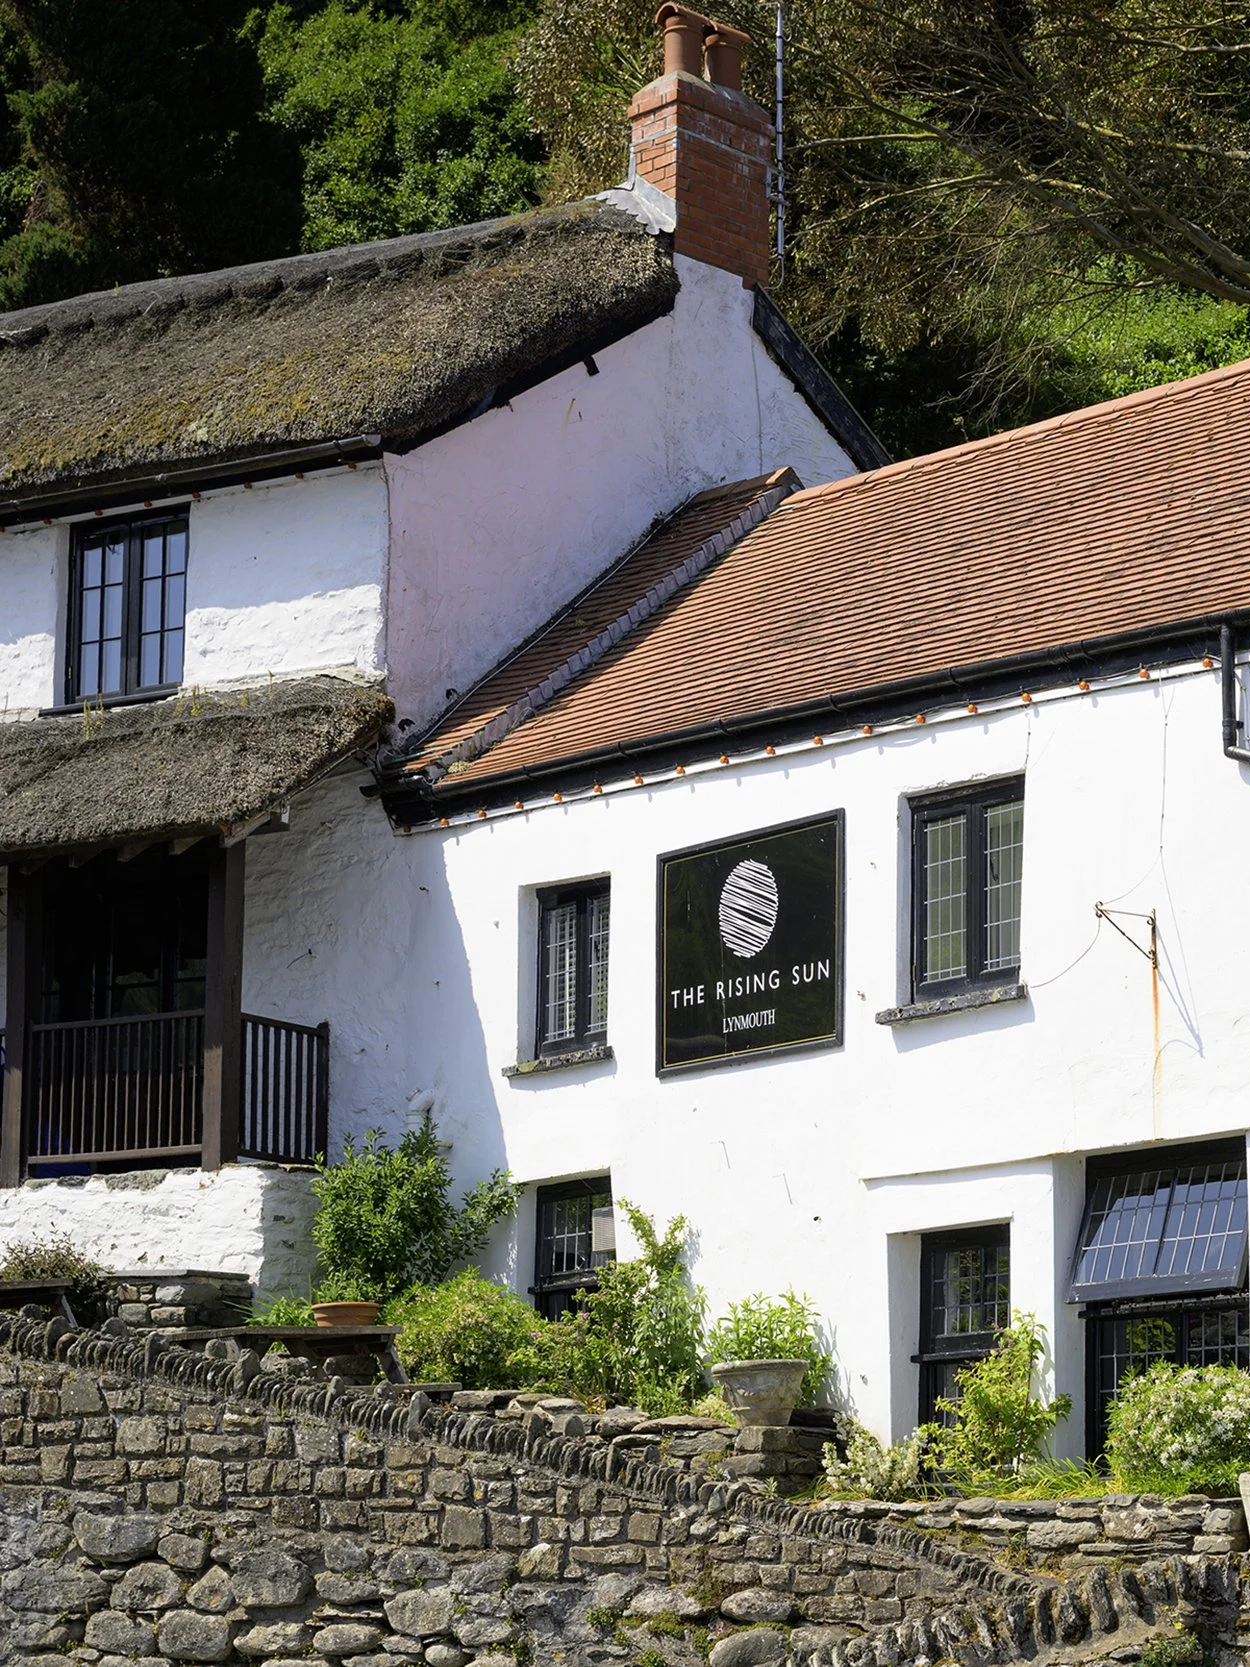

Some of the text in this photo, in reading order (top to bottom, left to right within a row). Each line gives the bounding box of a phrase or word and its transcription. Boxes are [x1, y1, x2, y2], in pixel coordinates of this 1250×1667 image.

[671, 958, 830, 1009] THE RISING SUN
[722, 1008, 776, 1034] LYNMOUTH
